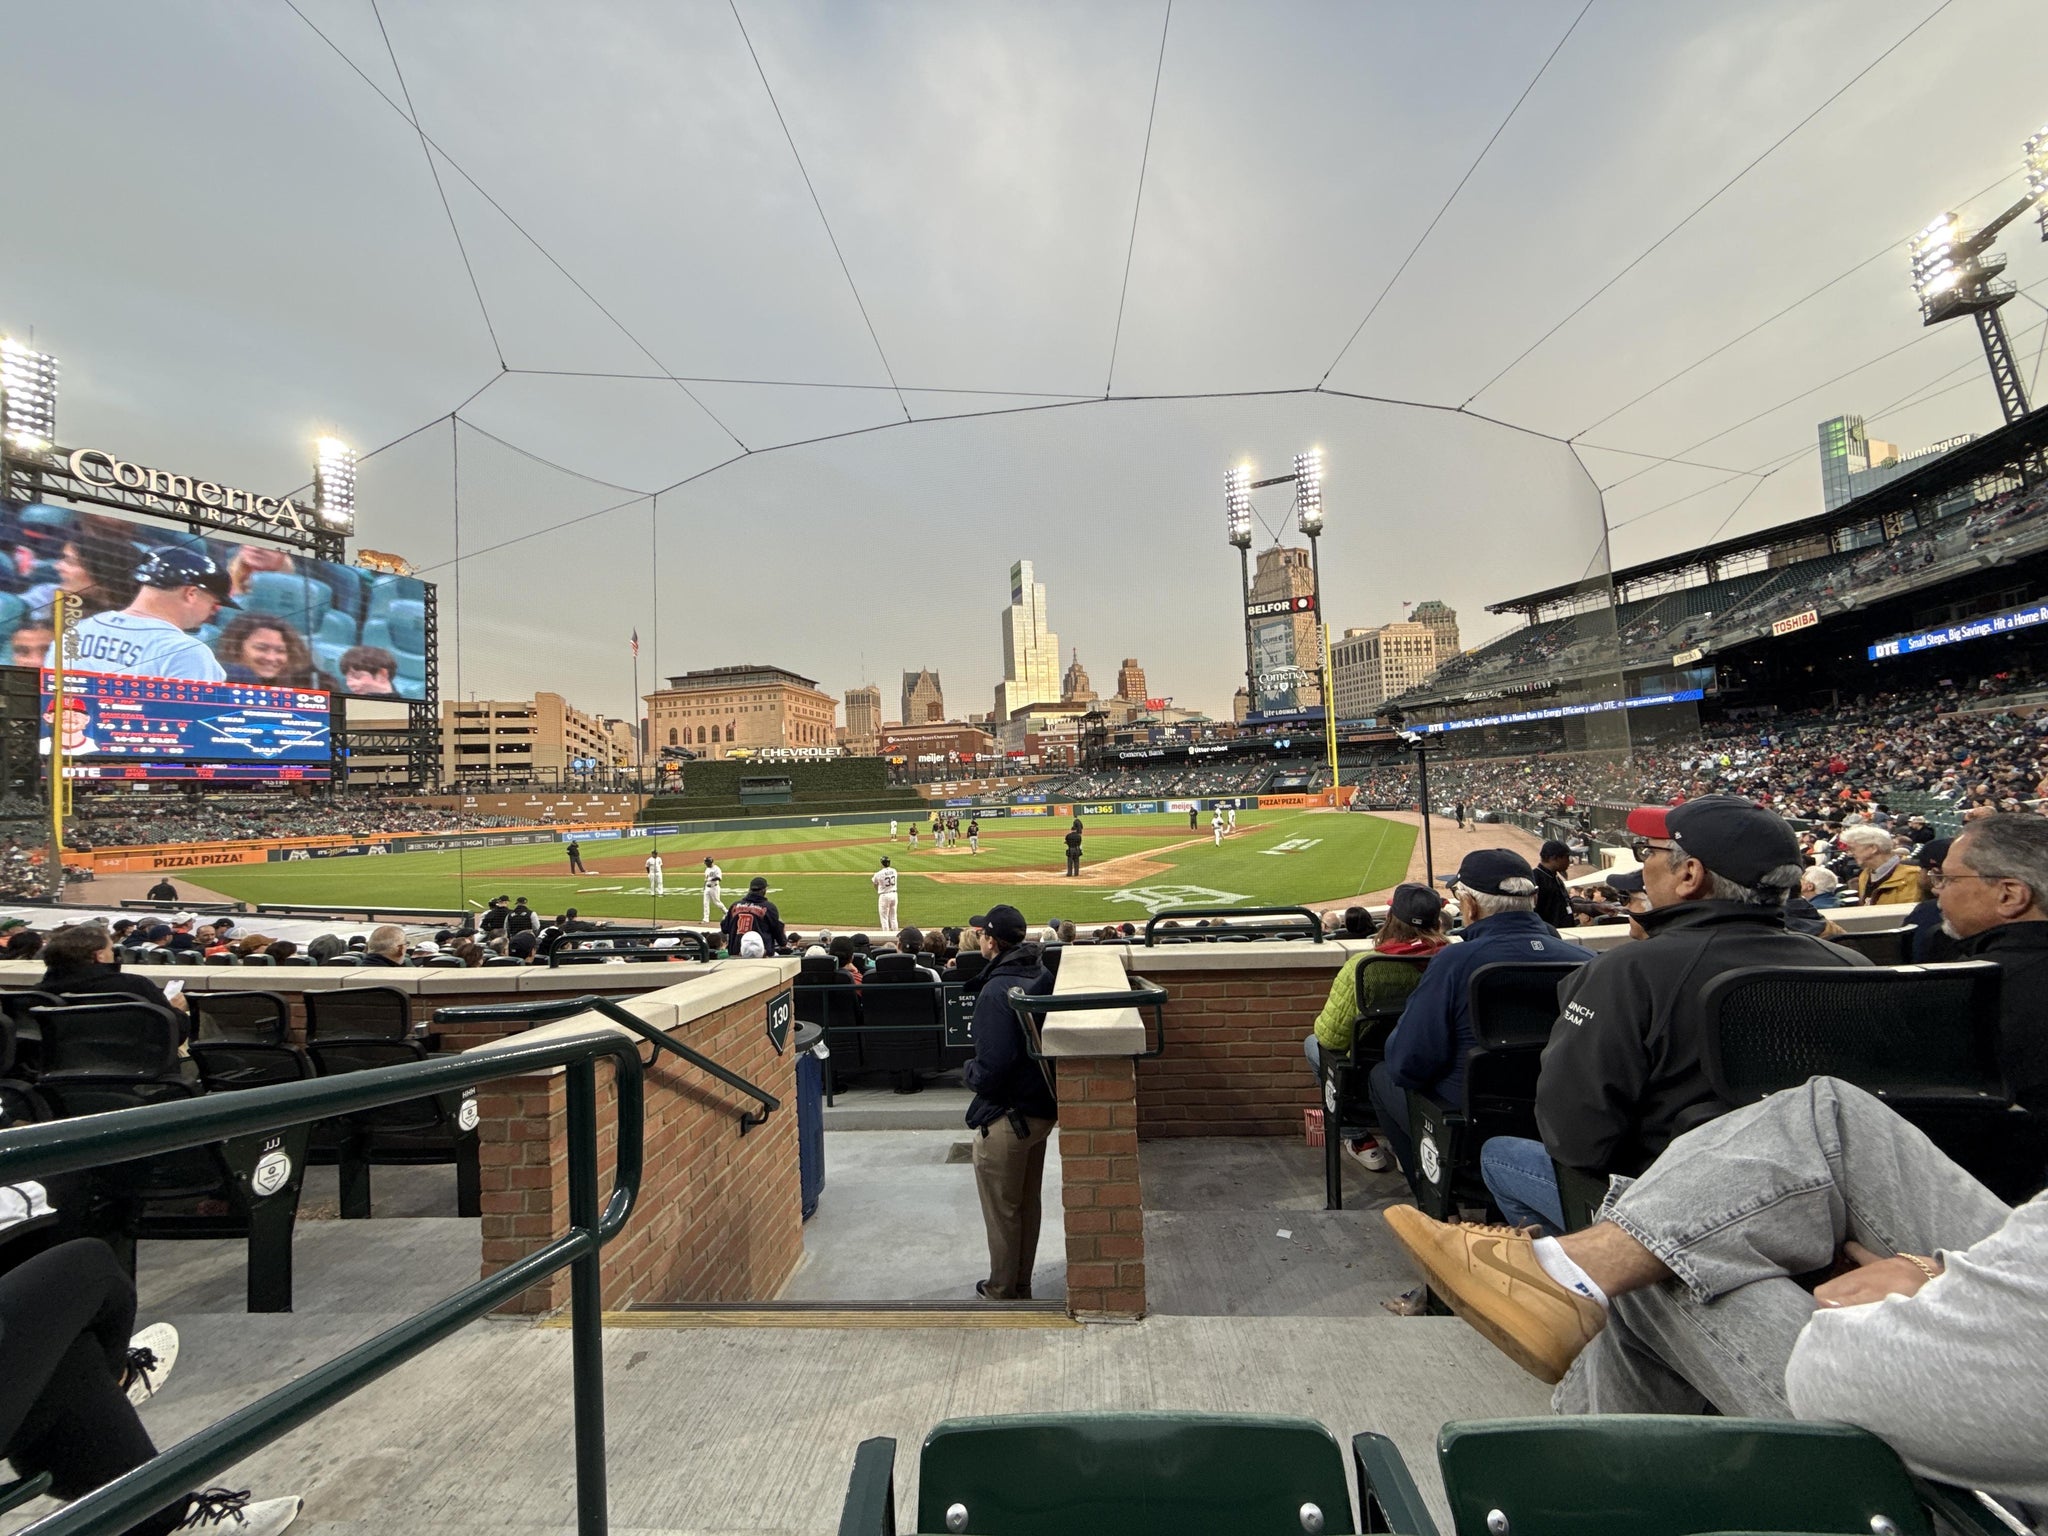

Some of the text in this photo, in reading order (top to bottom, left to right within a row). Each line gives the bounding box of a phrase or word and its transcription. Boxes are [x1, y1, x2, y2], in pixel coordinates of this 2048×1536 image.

[1897, 434, 1971, 463] Huntington
[145, 493, 250, 528] PARK
[1248, 601, 1290, 615] BELFOR
[1774, 612, 1816, 634] TOSHIBA
[1876, 642, 1900, 657] DTE
[1908, 638, 1927, 650] Small
[1927, 634, 1948, 645] Steps,
[1948, 629, 1962, 642] Big
[1961, 623, 1992, 638] Savings.
[1993, 617, 2007, 631] Hit
[2008, 620, 2014, 628] a
[2014, 612, 2040, 626] Home
[81, 634, 143, 668] OGERS
[1428, 723, 1444, 732] DTE
[761, 747, 842, 757] CHEVROLET
[918, 753, 945, 764] meijer
[745, 757, 832, 765] FOUNTAIN
[62, 767, 101, 777] DTE
[1259, 797, 1304, 806] PIZZA! PIZZA!
[1083, 805, 1113, 814] bet365
[629, 828, 647, 837] DTE
[455, 839, 484, 848] BETMGM
[153, 853, 243, 868] PIZZA! PIZZA!
[884, 875, 896, 887] 33
[772, 1004, 788, 1029] 130
[1568, 1001, 1595, 1019] UNCH
[264, 1137, 281, 1152] JJJ
